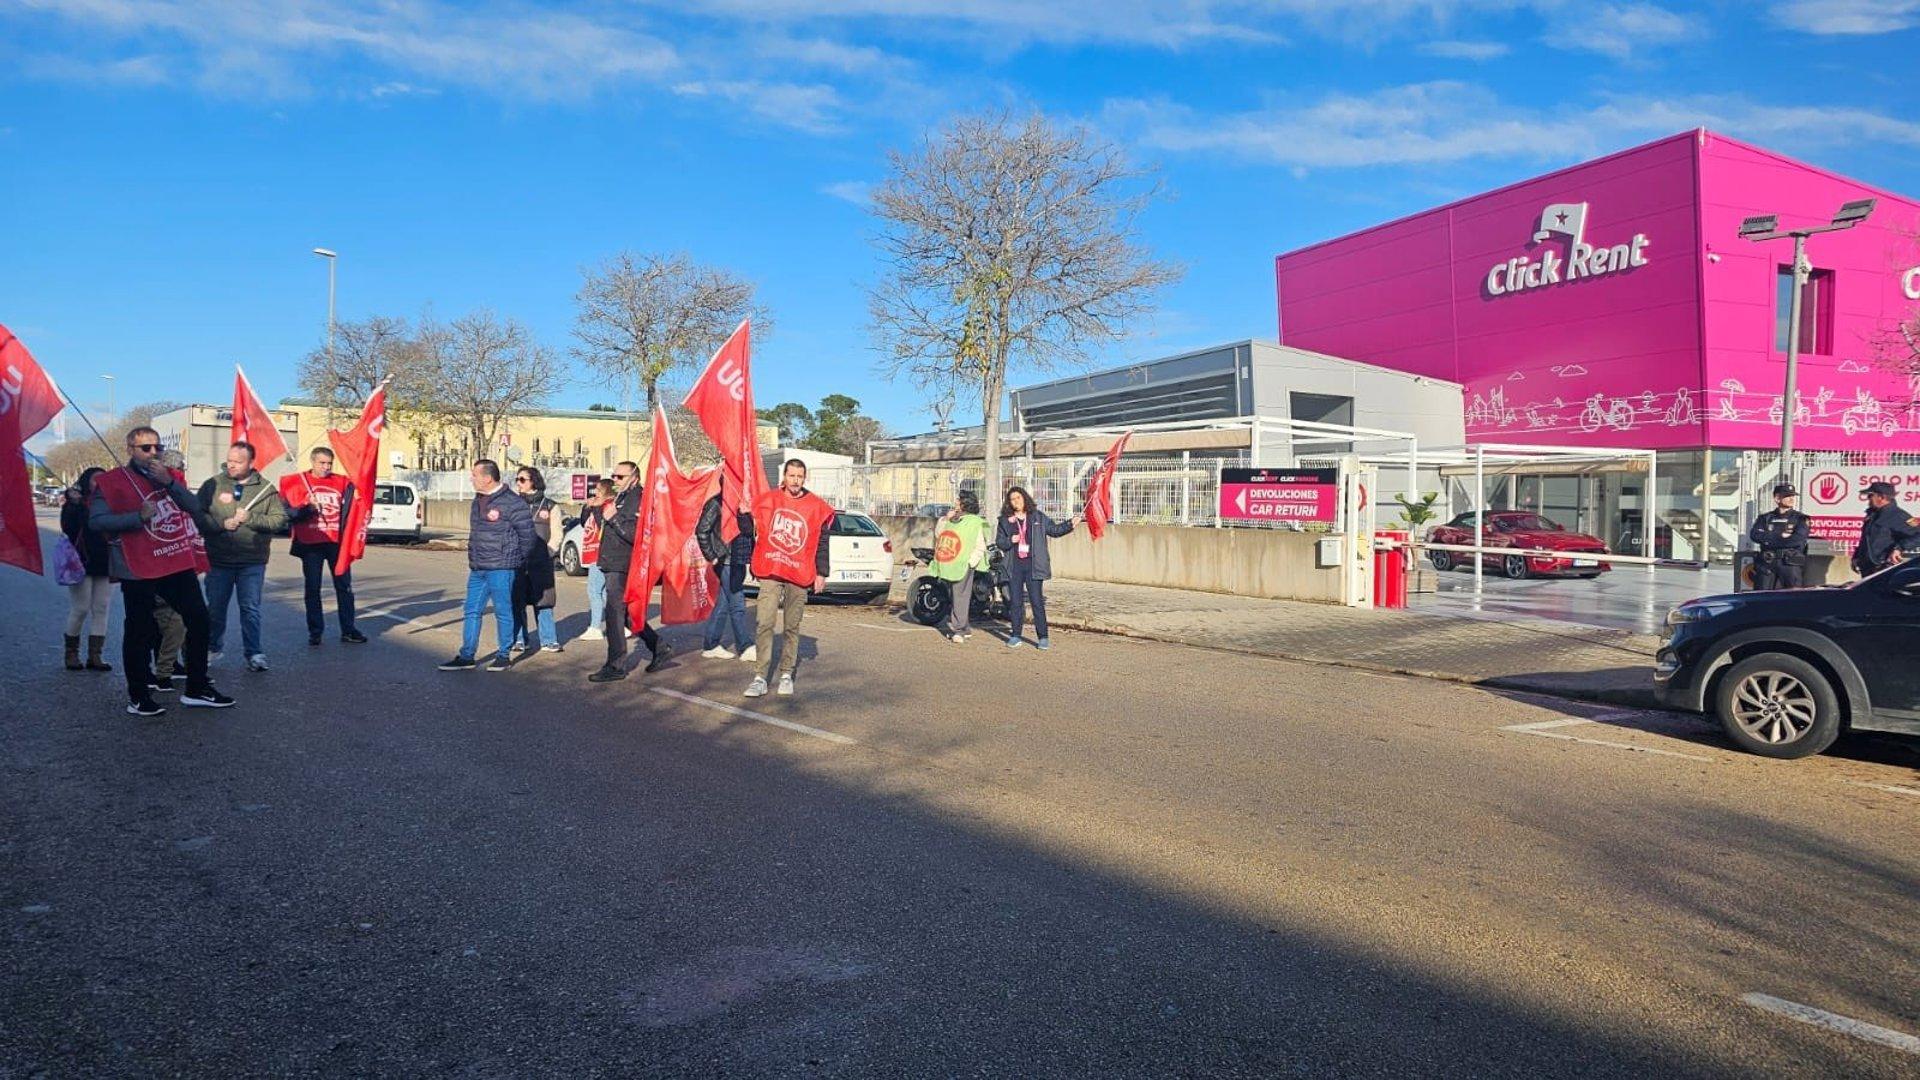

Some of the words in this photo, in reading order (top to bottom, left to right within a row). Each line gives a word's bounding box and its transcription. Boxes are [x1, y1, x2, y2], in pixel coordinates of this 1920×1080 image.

[1488, 250, 1561, 295] Click
[1566, 234, 1649, 280] Rent
[1250, 489, 1318, 500] DEVOLUCIONES
[1250, 503, 1273, 515] CAR
[1275, 504, 1317, 517] RETURN
[773, 513, 803, 539] UGT
